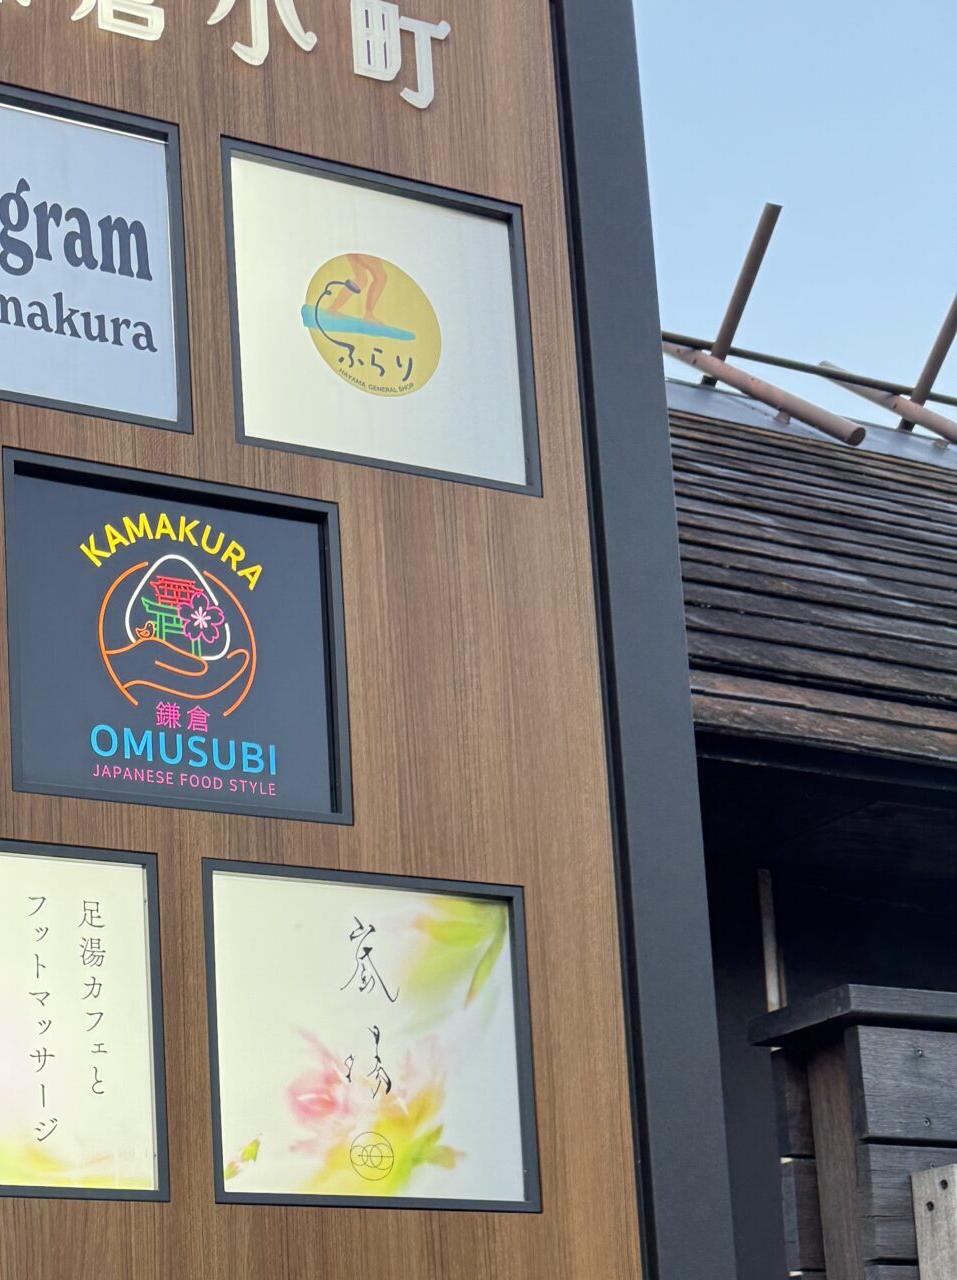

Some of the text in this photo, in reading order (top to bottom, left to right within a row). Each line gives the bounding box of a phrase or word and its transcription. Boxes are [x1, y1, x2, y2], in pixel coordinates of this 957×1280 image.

[338, 343, 413, 382] ふらり
[338, 368, 414, 393] HAYAMA GENERAL SHOP
[79, 513, 263, 591] KAMAKURA
[155, 701, 210, 733] 鎌倉
[90, 724, 277, 776] OMUSUBI
[92, 764, 277, 796] JAPANESE FOOD STYLE
[28, 895, 58, 1142] フットマッサージ
[78, 900, 108, 1095] 足湯カフェと
